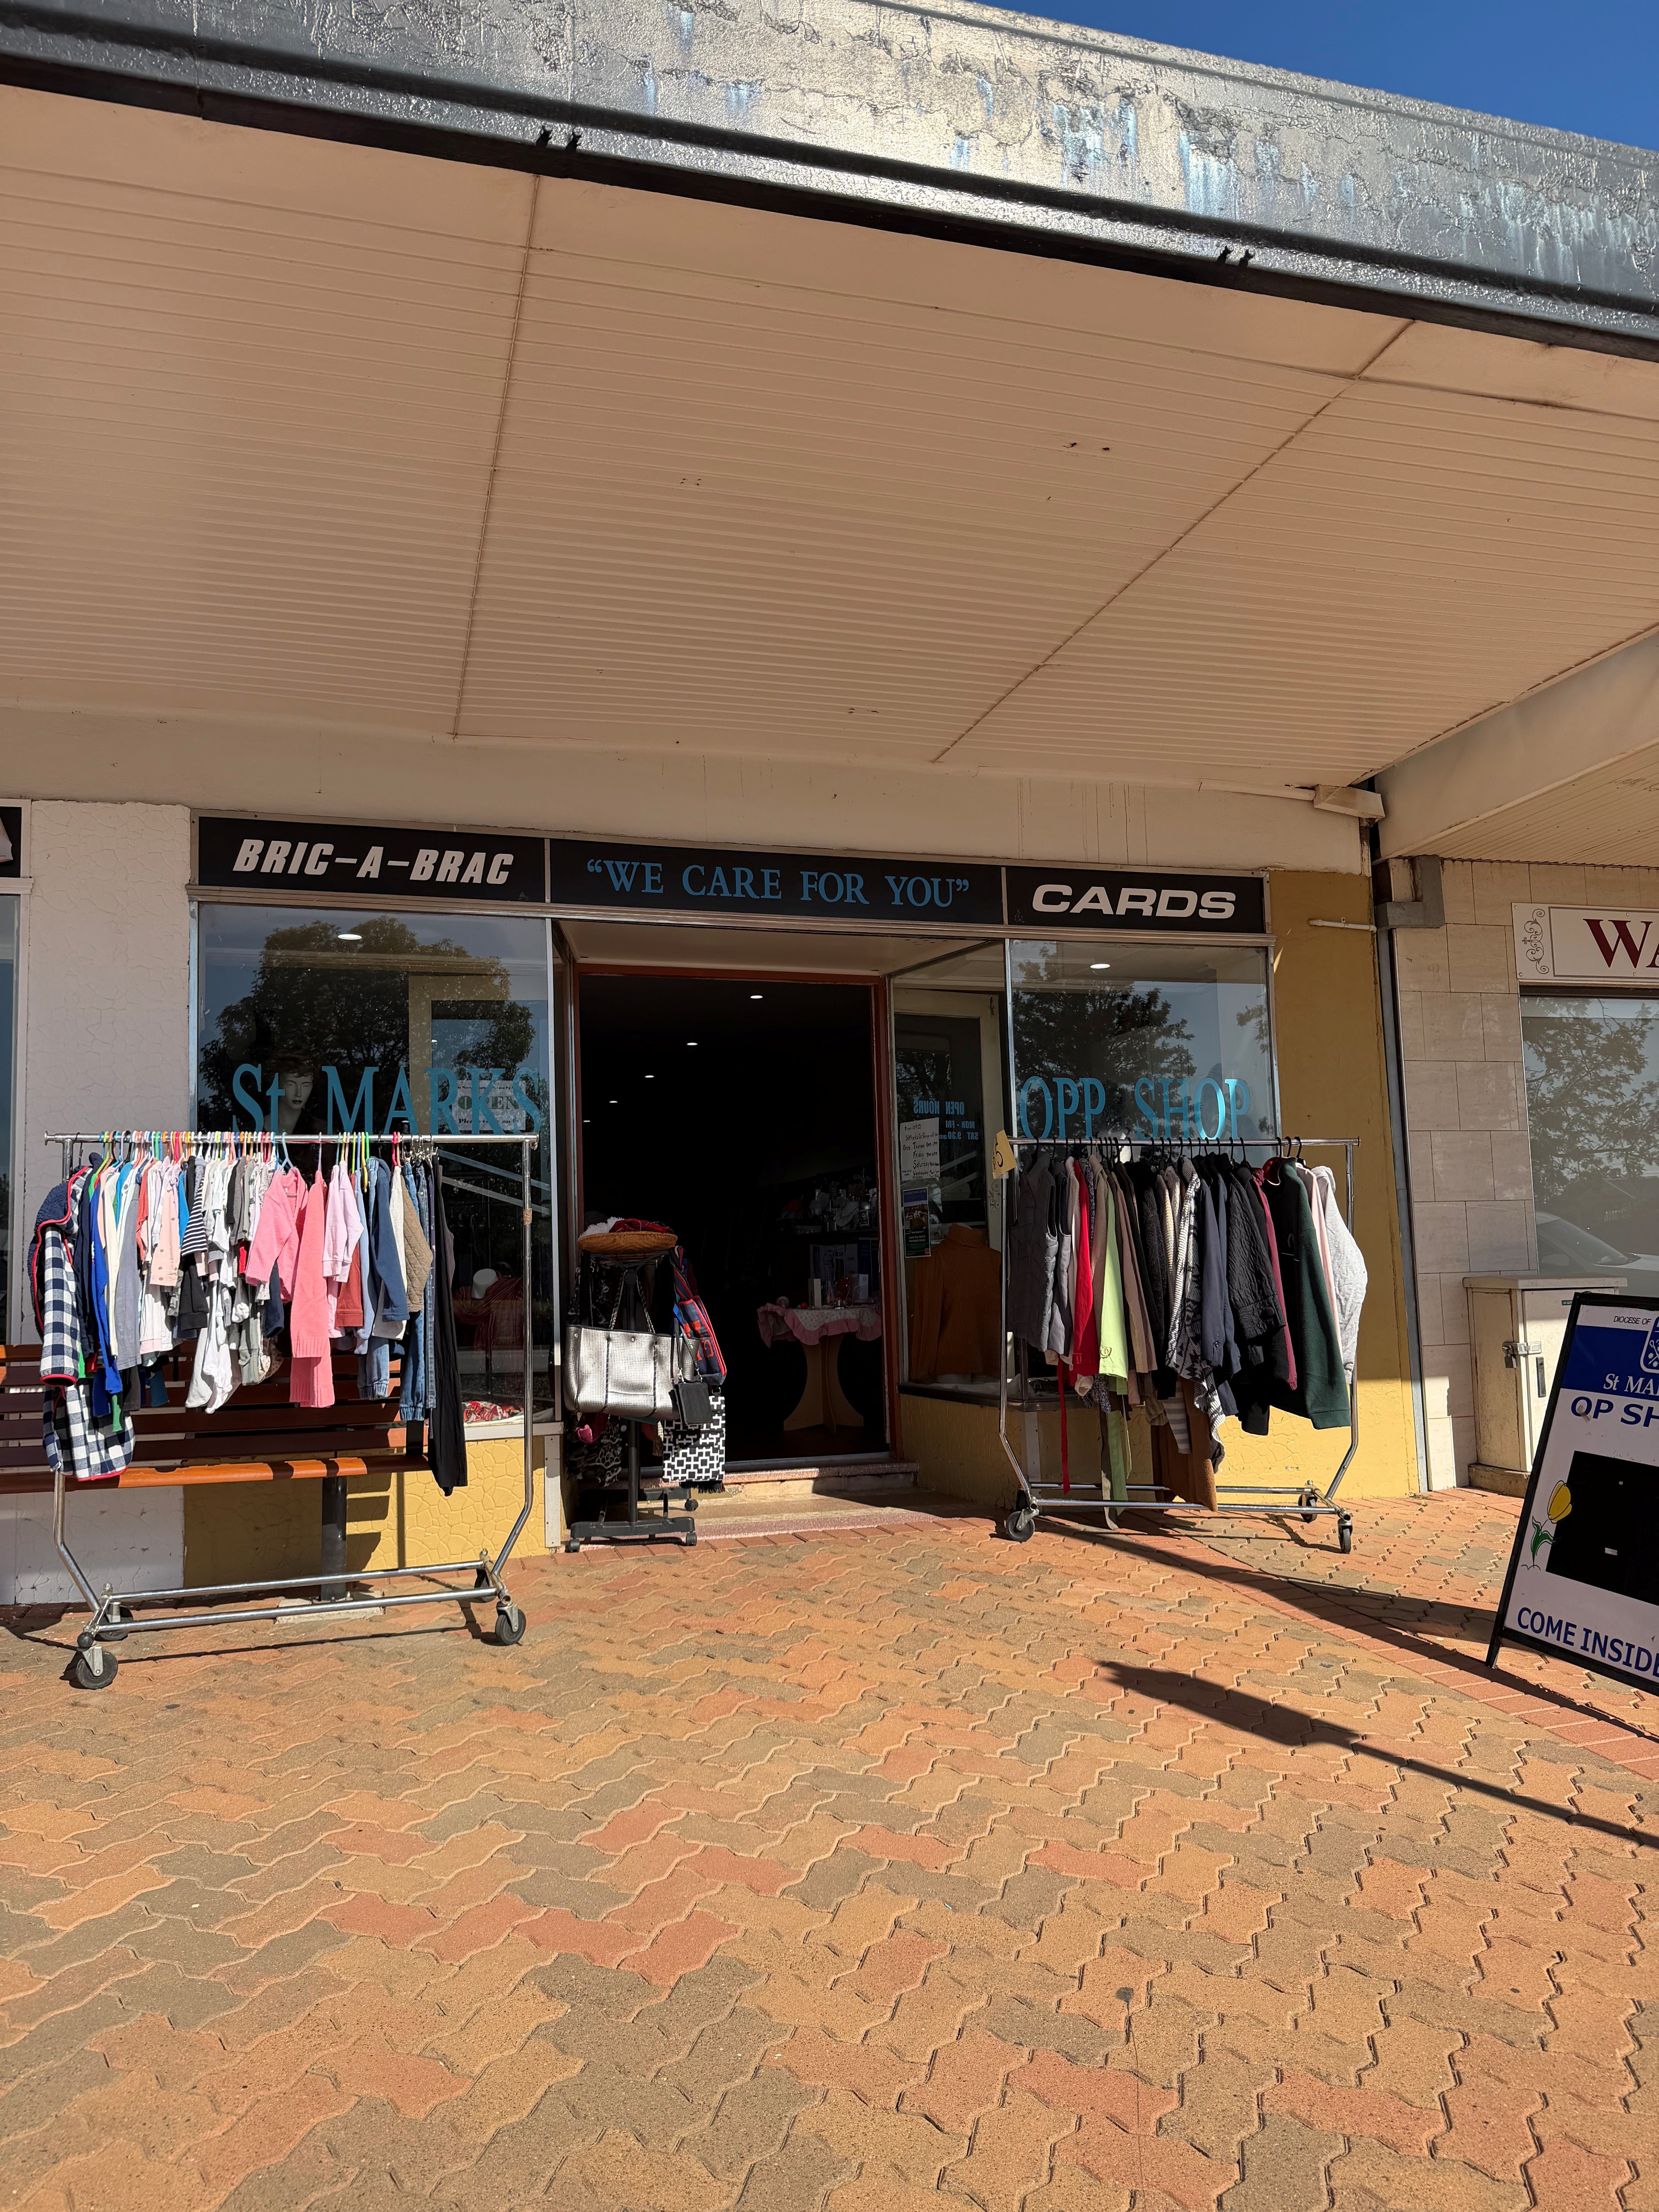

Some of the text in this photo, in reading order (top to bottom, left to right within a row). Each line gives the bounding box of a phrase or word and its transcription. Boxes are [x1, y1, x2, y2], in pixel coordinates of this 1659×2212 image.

[232, 839, 514, 884] BRIC-A-BRAC
[682, 865, 783, 900] CARE
[800, 871, 869, 905] FOR
[1032, 884, 1236, 919] CARDS
[233, 1063, 541, 1135] St MARKS
[1020, 1075, 1250, 1140] OPP SHOP
[1613, 1316, 1641, 1324] DIOCESE
[1603, 1373, 1659, 1396] St MA
[1571, 1396, 1614, 1419] OP
[1517, 1607, 1577, 1646] COME
